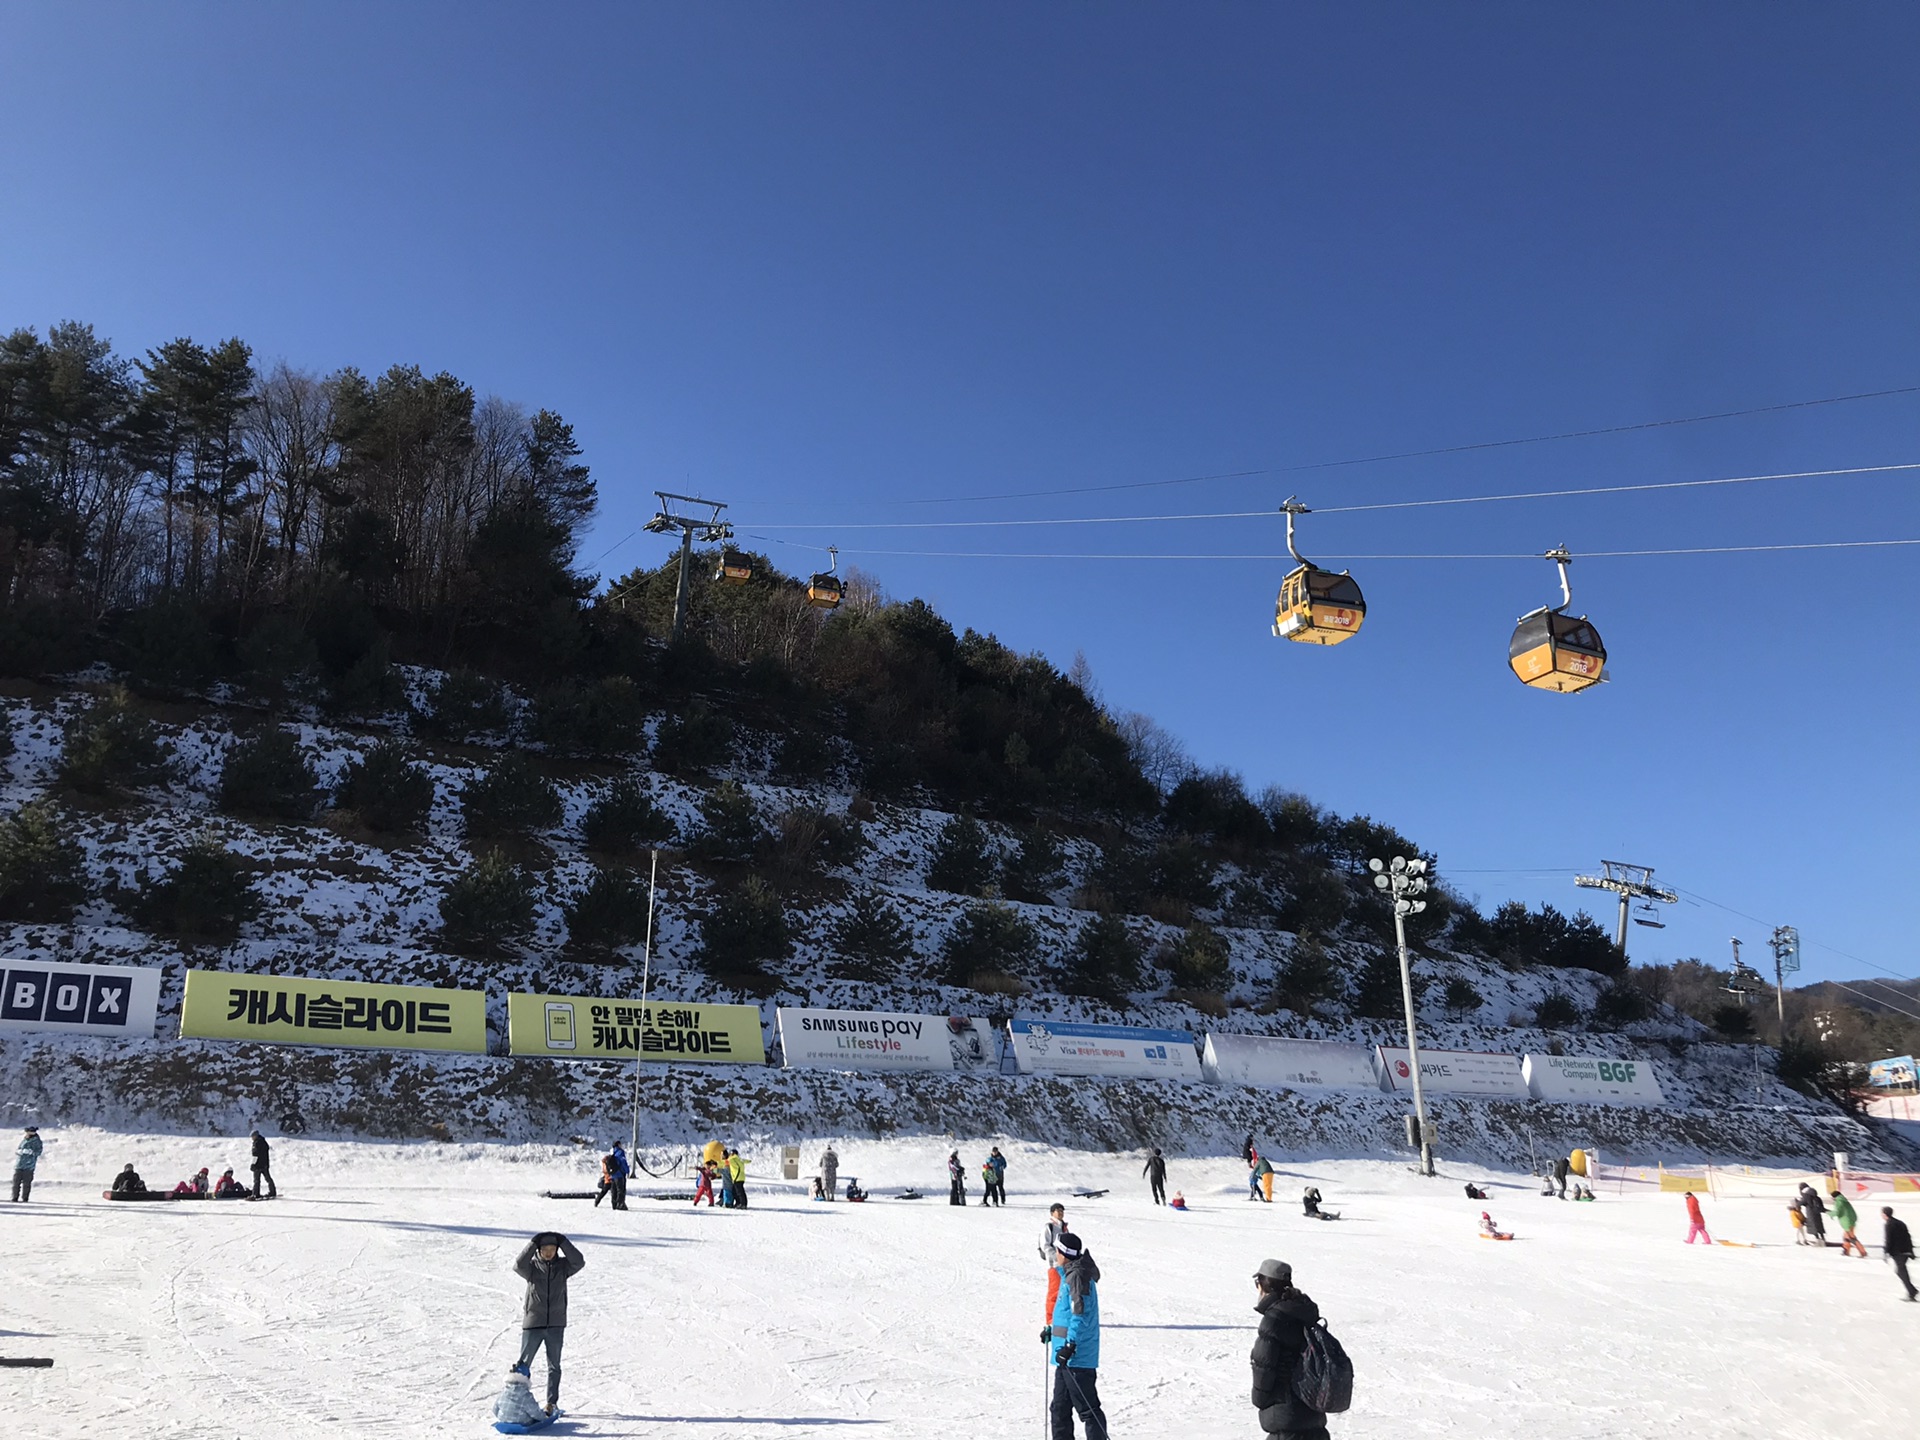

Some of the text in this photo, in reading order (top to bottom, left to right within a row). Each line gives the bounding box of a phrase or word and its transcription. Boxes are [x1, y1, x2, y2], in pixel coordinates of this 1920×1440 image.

[1569, 661, 1588, 674] 2018
[12, 982, 122, 1014] BOX
[227, 988, 452, 1033] 캐시슬라이드
[590, 1005, 700, 1029] 안 밀면 손해!
[592, 1026, 732, 1054] 캐시슬라이드
[801, 1017, 922, 1040] SAMSUNG pay
[836, 1036, 902, 1053] Lifestyle
[1060, 1046, 1077, 1055] Visa
[1419, 1063, 1453, 1078] 씨카드
[1548, 1058, 1636, 1083] Life Network BGF
[1562, 1068, 1598, 1081] Company
